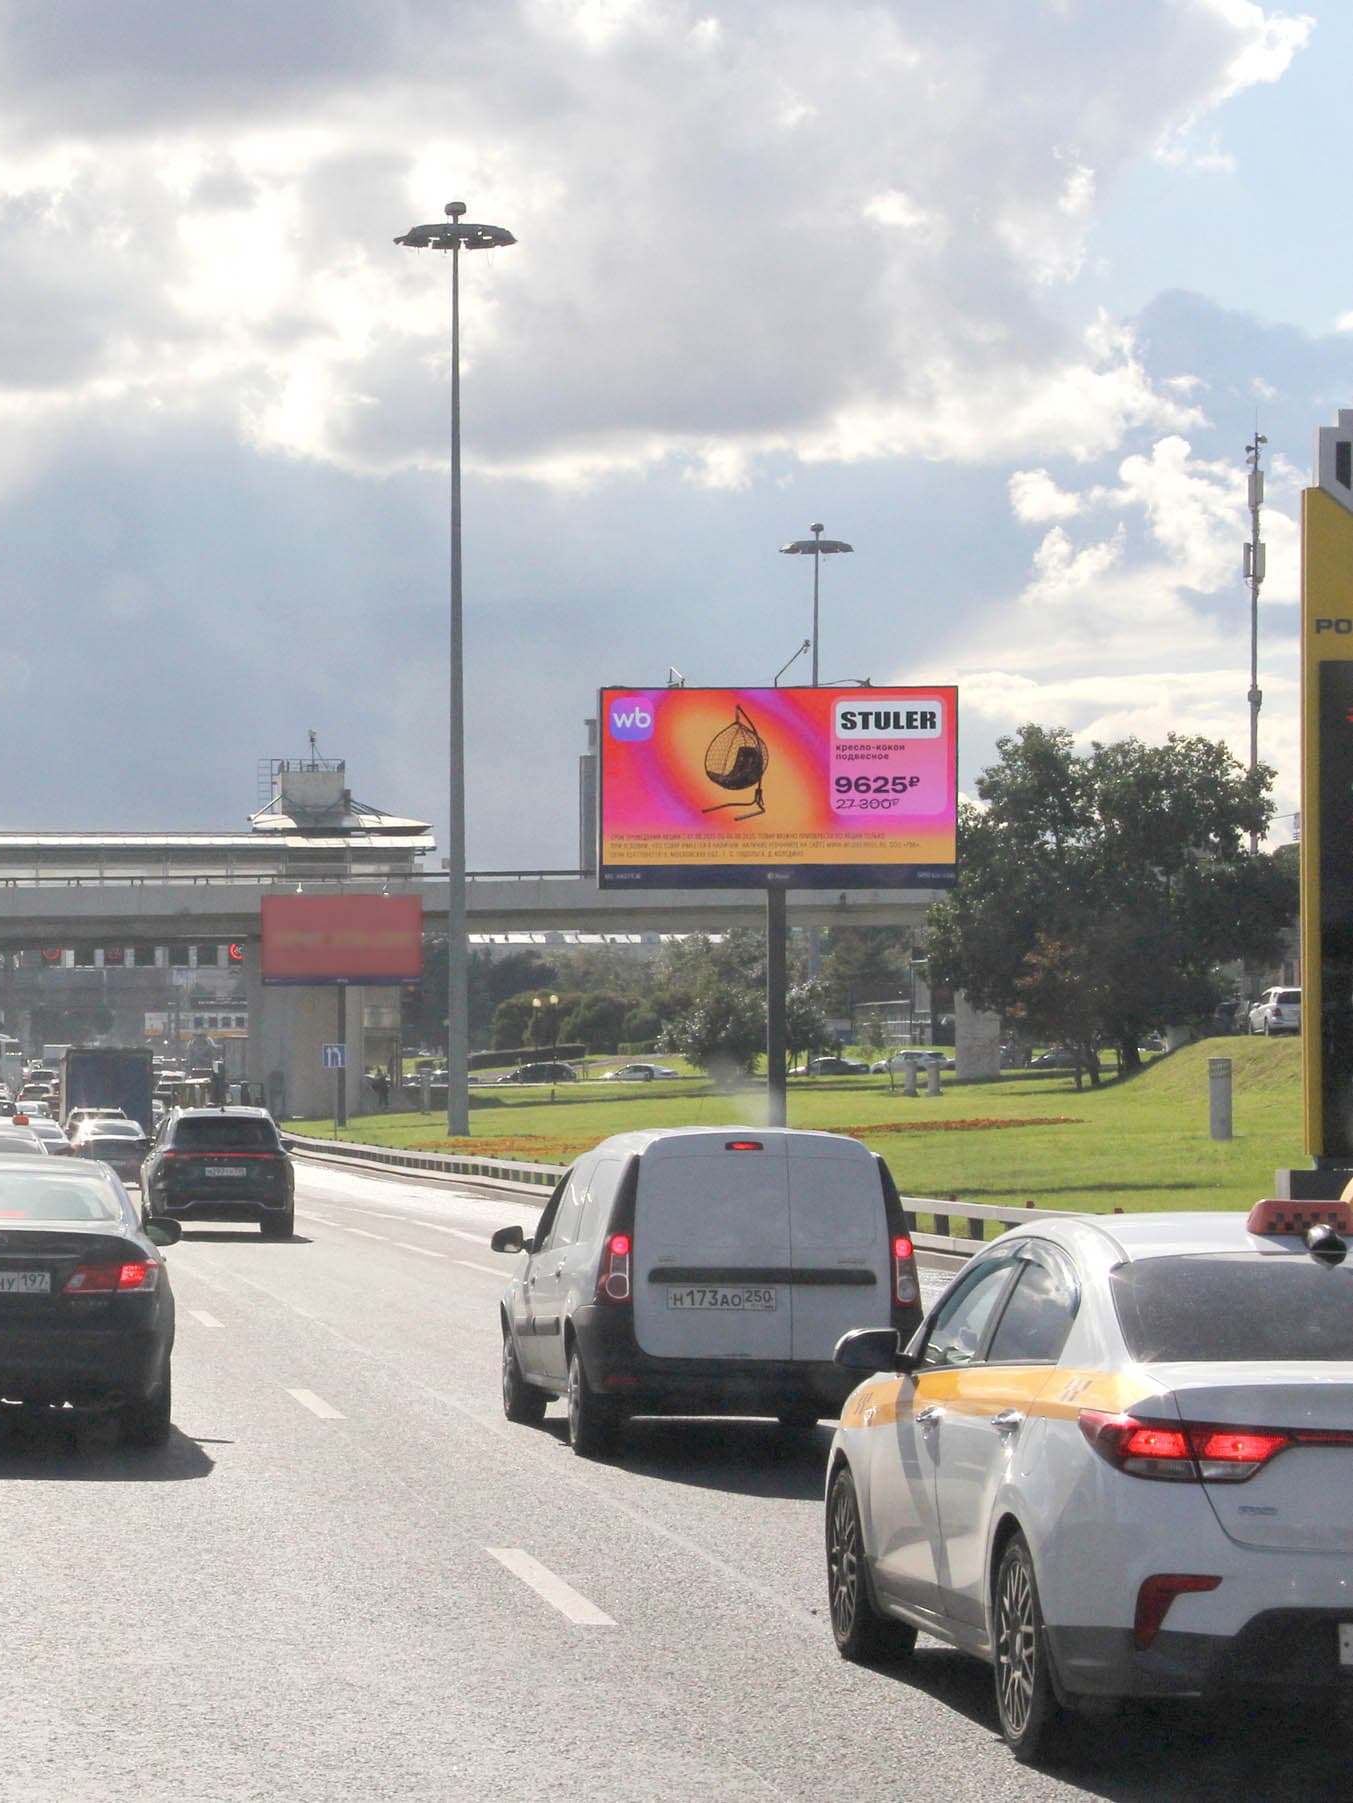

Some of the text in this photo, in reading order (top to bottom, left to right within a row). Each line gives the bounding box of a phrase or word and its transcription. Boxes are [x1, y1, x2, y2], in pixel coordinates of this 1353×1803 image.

[613, 706, 652, 728] wb
[840, 711, 937, 730] STULER
[835, 744, 906, 752] кресло-кокон
[835, 753, 890, 761] подвесное
